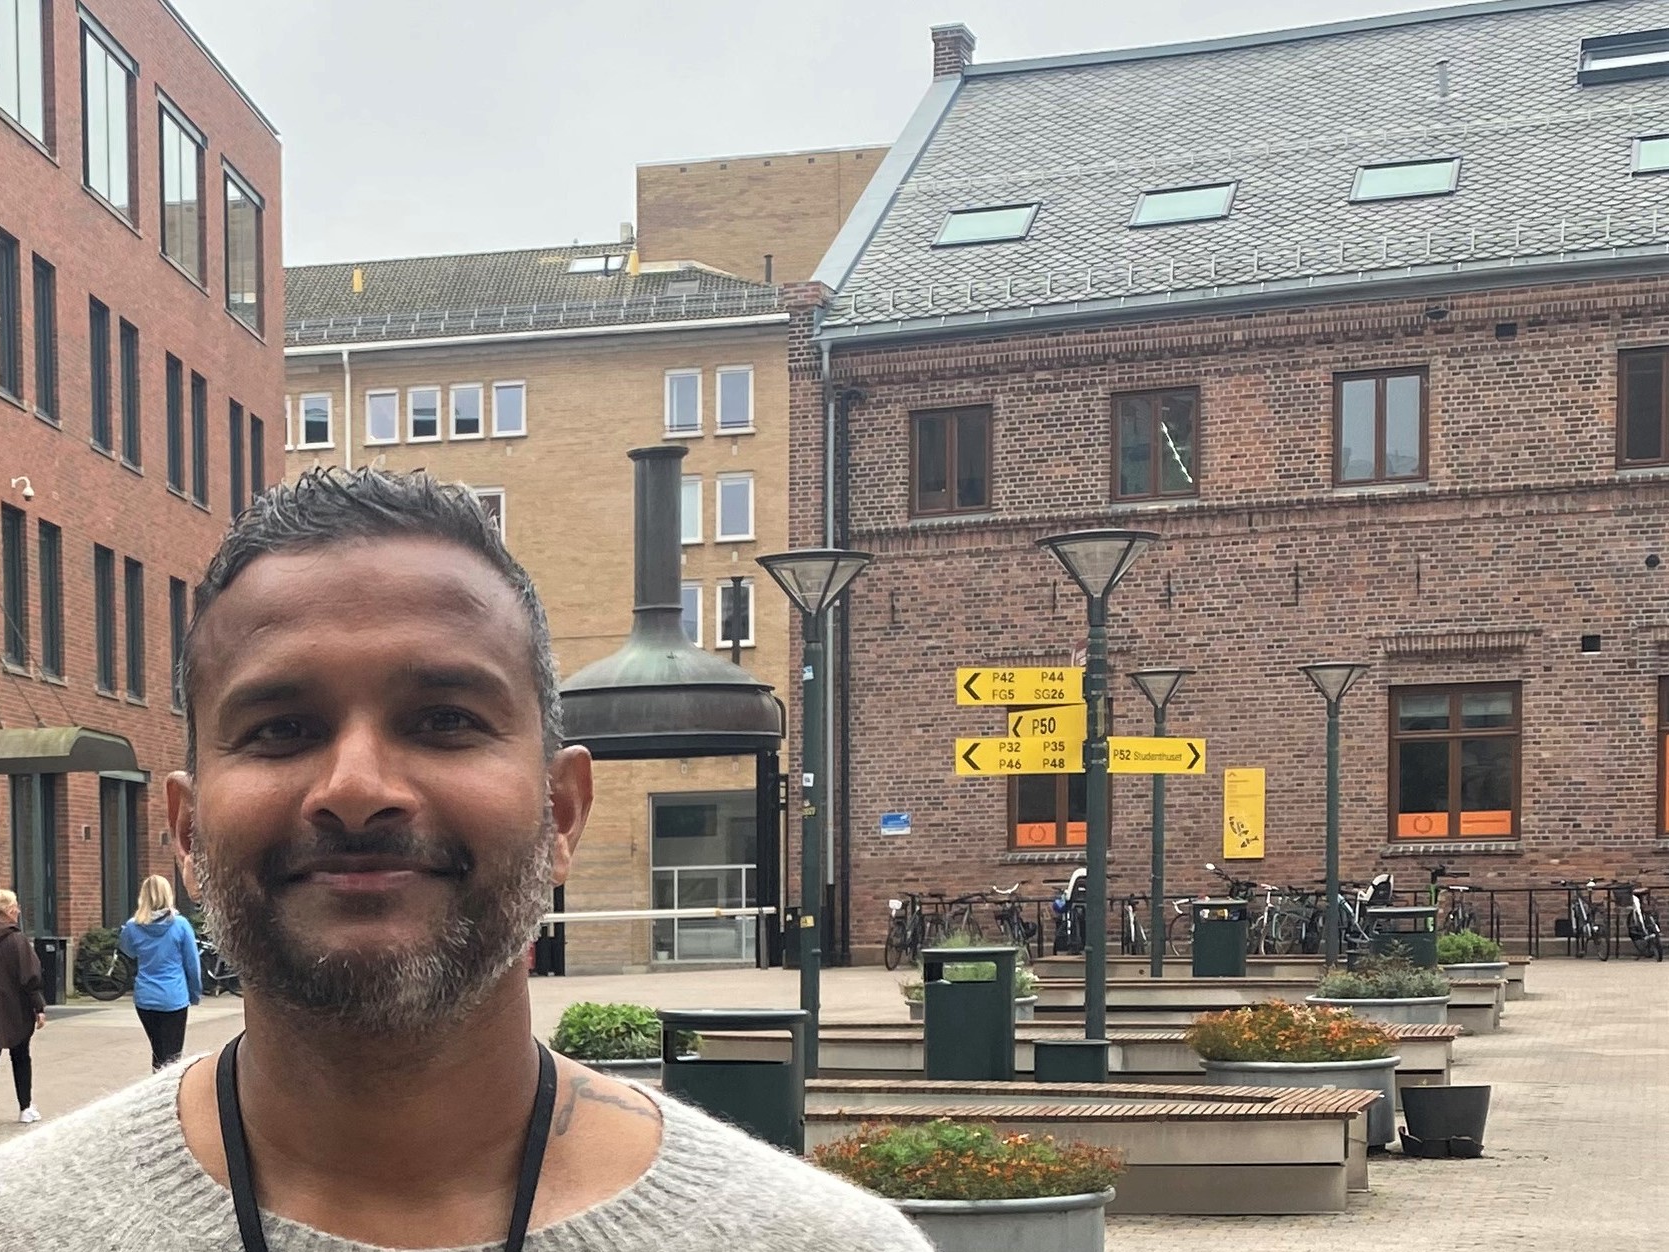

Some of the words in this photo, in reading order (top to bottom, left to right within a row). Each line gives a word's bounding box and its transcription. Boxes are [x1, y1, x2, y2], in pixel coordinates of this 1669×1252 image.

[992, 672, 1015, 683] P42
[1041, 671, 1065, 682] P44
[992, 689, 1015, 700] FG5
[1034, 689, 1065, 700] SG26
[1032, 716, 1056, 736] P50
[999, 742, 1021, 753] P32
[1043, 741, 1066, 752] P35
[1113, 749, 1131, 760] P52
[999, 759, 1022, 770] P46
[1043, 758, 1066, 769] P48
